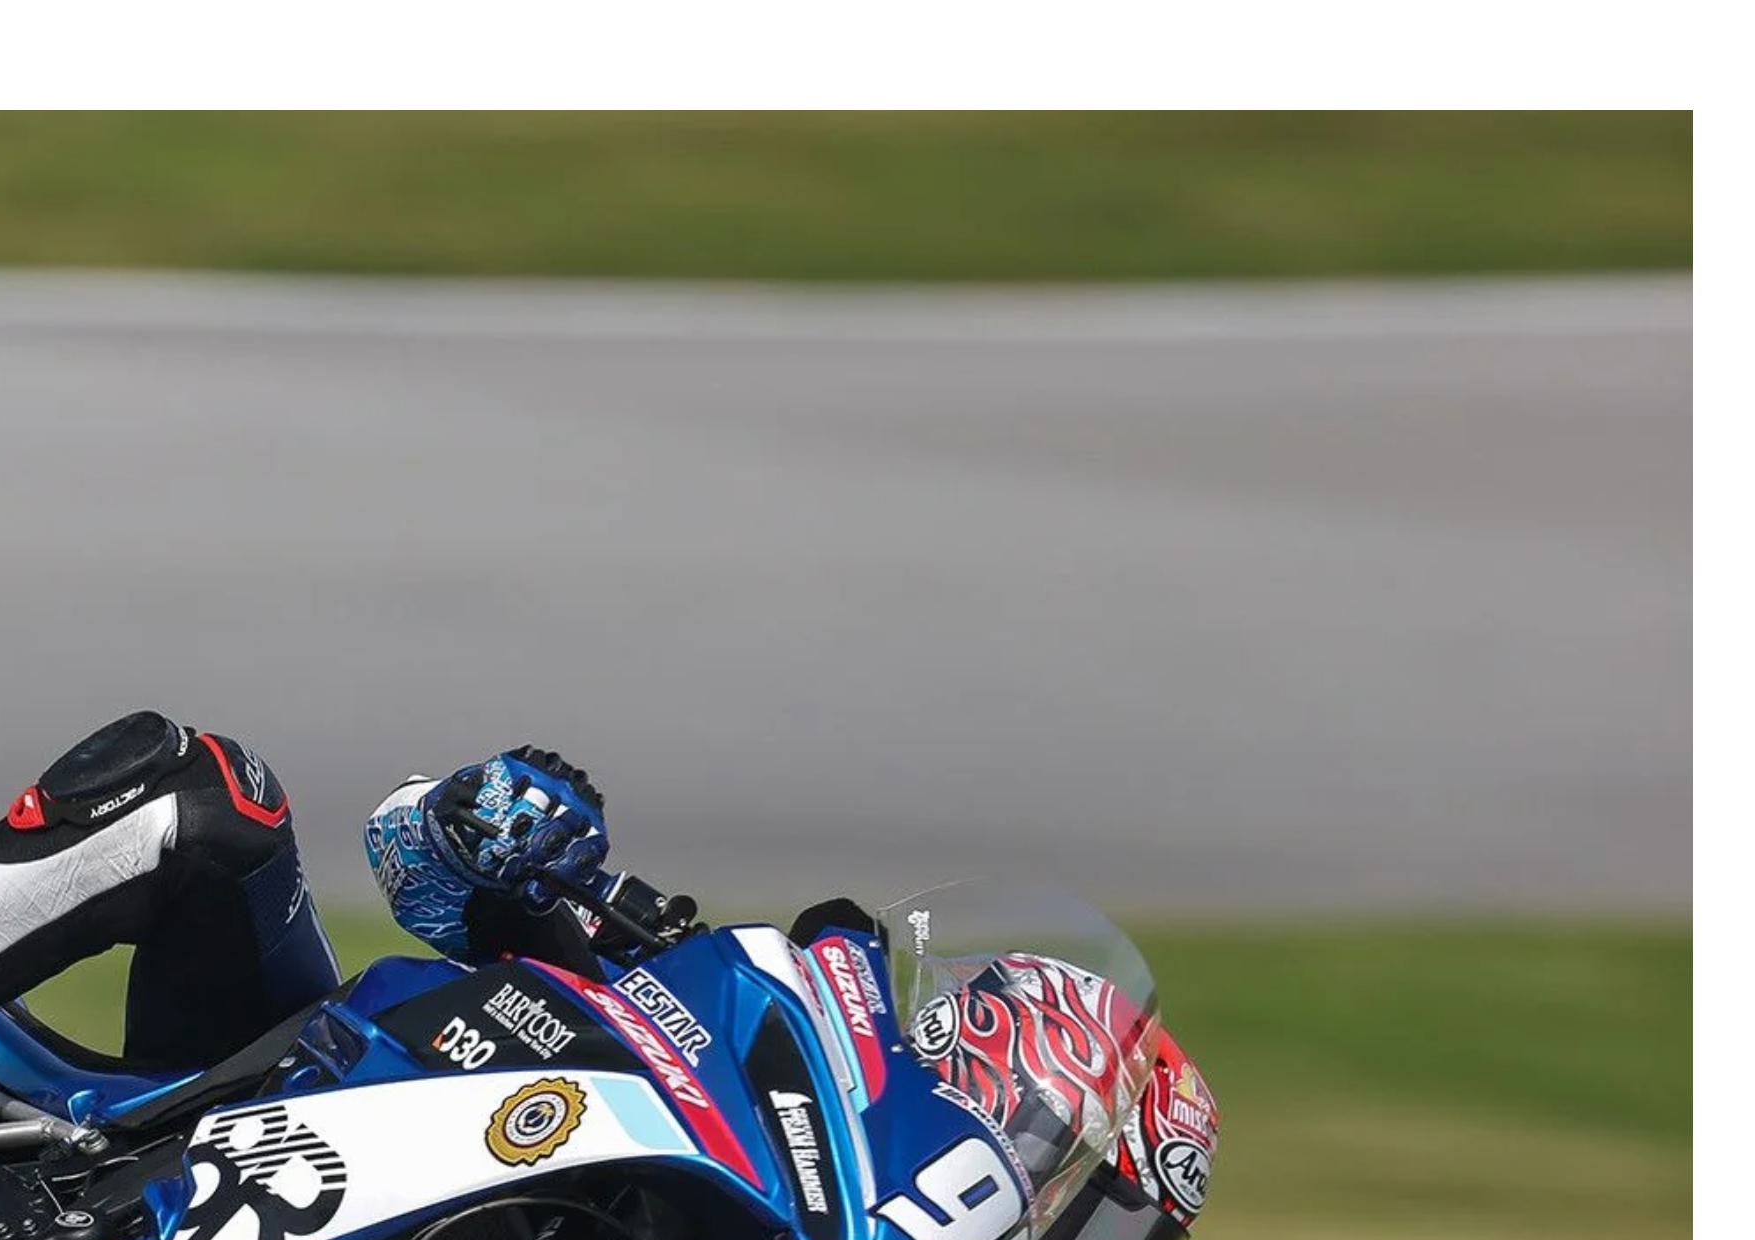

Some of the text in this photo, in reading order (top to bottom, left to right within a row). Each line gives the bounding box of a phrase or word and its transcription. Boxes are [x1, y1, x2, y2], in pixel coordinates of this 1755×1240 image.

[612, 967, 712, 1068] ECSTAR
[822, 945, 874, 1037] SUZUKI
[583, 988, 710, 1108] SUZUKI
